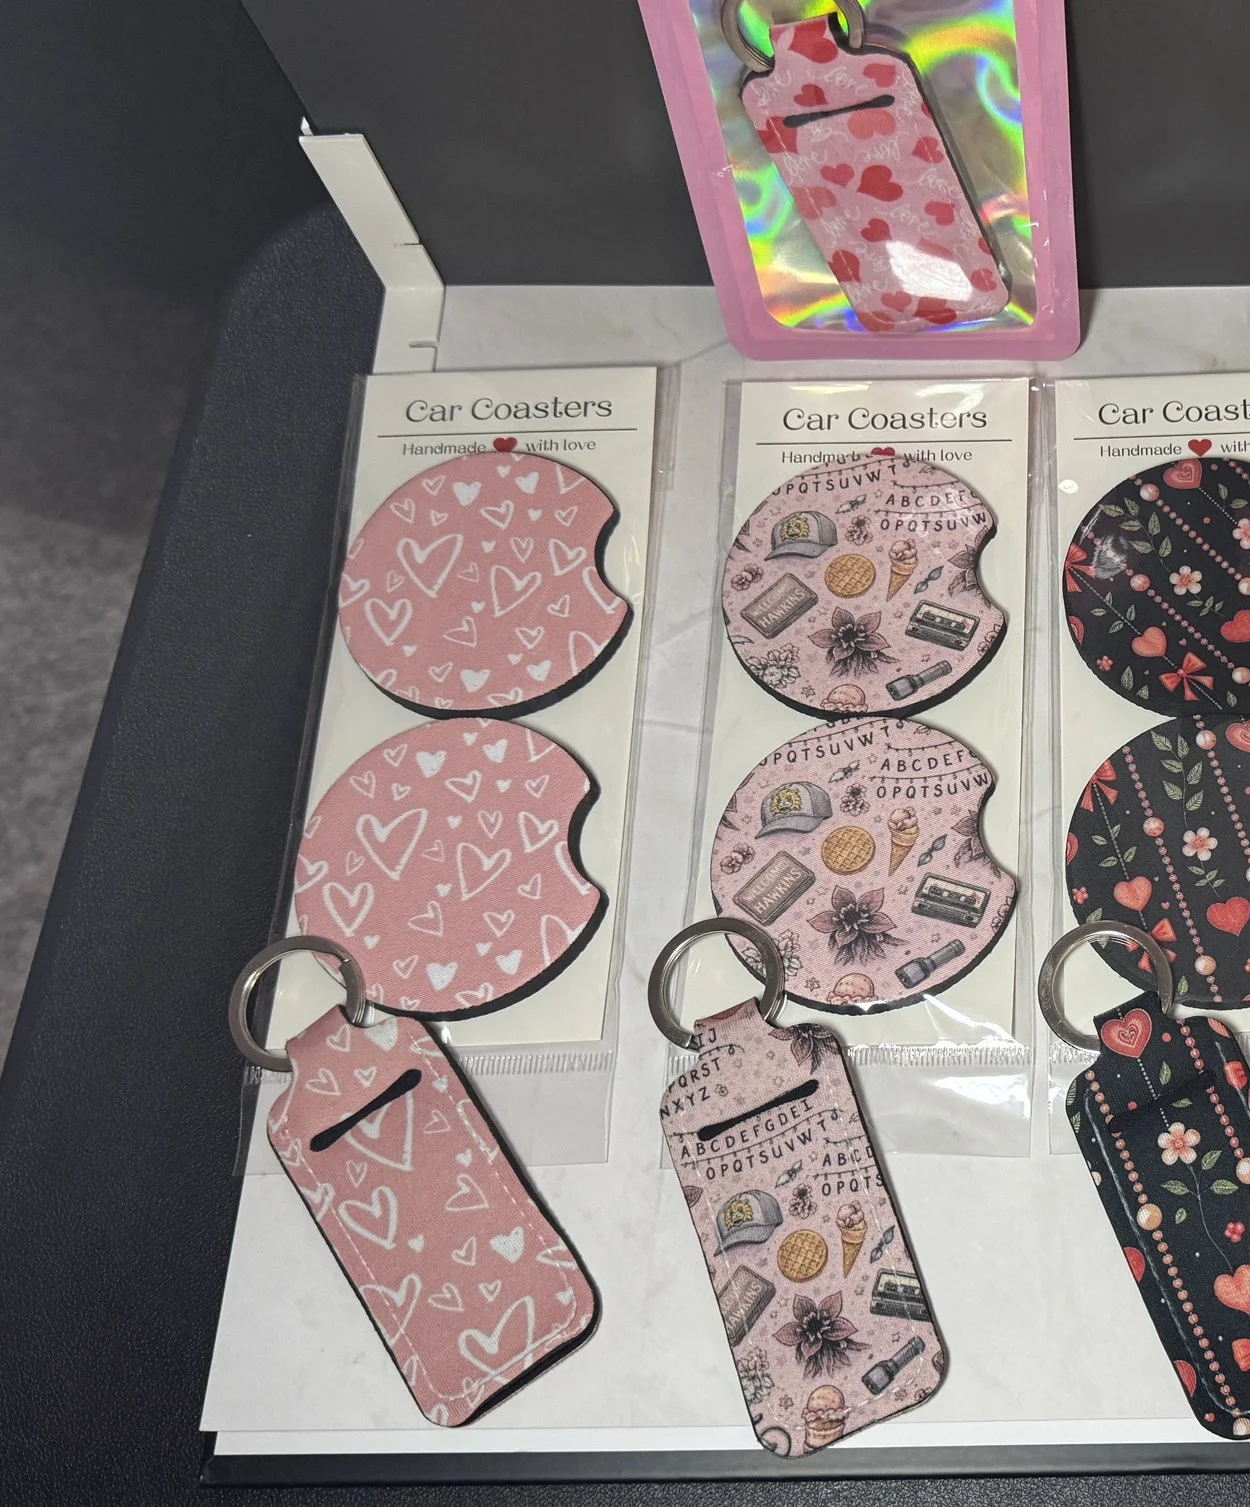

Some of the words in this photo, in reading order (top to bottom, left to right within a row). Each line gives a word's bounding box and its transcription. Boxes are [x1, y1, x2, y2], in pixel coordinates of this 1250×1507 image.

[405, 399, 463, 423] Car
[470, 396, 613, 421] Coasters
[782, 408, 839, 431] Car
[848, 407, 988, 430] Coasters
[1098, 403, 1154, 425] Car
[402, 441, 487, 456] Handmade
[525, 438, 559, 453] with
[563, 438, 597, 452] love
[903, 449, 936, 461] with
[940, 449, 973, 462] love
[1100, 443, 1182, 458] Handmade
